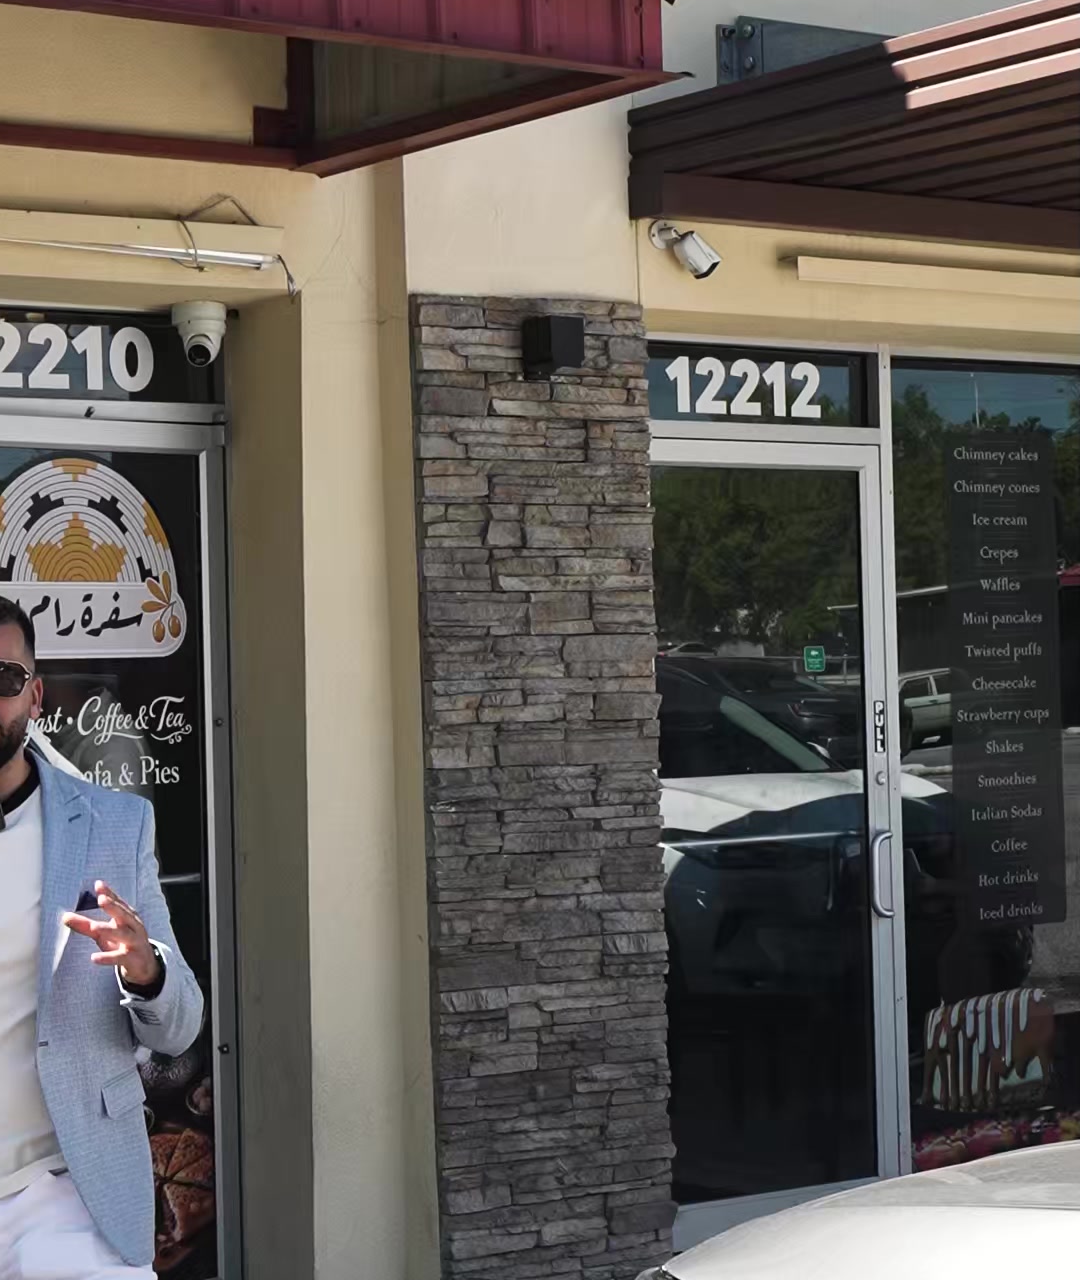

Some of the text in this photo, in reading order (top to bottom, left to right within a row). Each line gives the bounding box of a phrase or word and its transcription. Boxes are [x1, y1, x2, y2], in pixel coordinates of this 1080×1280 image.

[665, 356, 822, 419] 12212
[953, 446, 1038, 465] Chimney cakes
[953, 479, 1040, 497] Chimney cones
[972, 513, 1028, 526] Ice cream
[980, 546, 1019, 565] Crepes
[980, 577, 1021, 591] Waffles
[81, 591, 143, 637] سفرة
[962, 610, 1043, 630] Mini pancakes
[964, 642, 1042, 661] Twisted puffs
[972, 675, 1037, 691] Cheesecake
[77, 696, 135, 745] Coffee
[135, 705, 149, 731] &
[149, 696, 187, 734] Tea
[957, 707, 1050, 724] Strawberry cups
[874, 701, 884, 753] PULL
[985, 739, 1025, 754] Shakes
[119, 762, 134, 786] &
[140, 756, 180, 785] Pies
[977, 772, 1037, 788] Smoothies
[971, 803, 1042, 821] Italian Sodas
[991, 839, 1028, 853] Coffee
[978, 869, 1039, 887] Hot drinks
[979, 902, 1043, 920] Iced drinks
